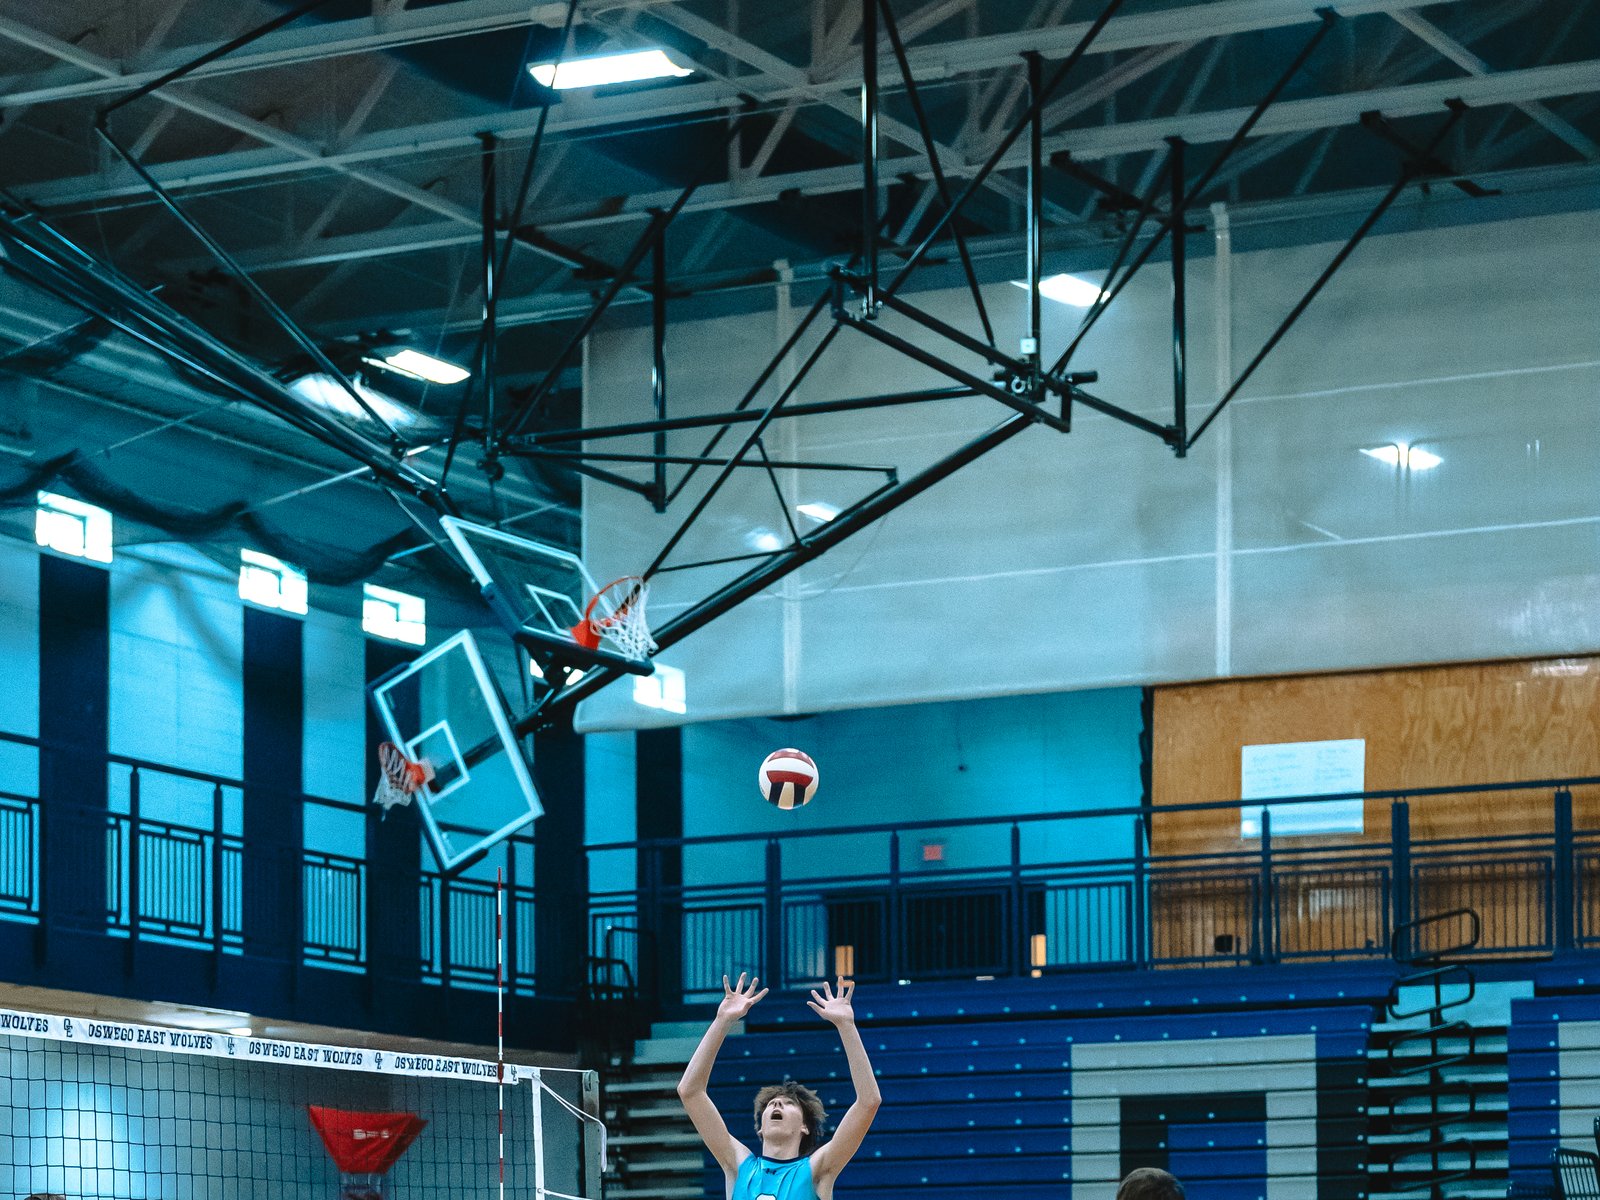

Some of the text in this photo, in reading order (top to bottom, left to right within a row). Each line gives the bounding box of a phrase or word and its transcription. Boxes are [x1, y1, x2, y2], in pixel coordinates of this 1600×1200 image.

[0, 1014, 48, 1032] WOLVES
[88, 1023, 134, 1041] OSWEGO
[137, 1029, 166, 1045] EAST
[170, 1032, 213, 1050] WOLVES
[249, 1041, 291, 1058] OSWEGO
[294, 1046, 320, 1062] EAST
[323, 1050, 363, 1065] WOLVES
[395, 1056, 434, 1071] OSWEGO
[435, 1058, 460, 1074] EAST
[462, 1062, 497, 1078] WOLVES
